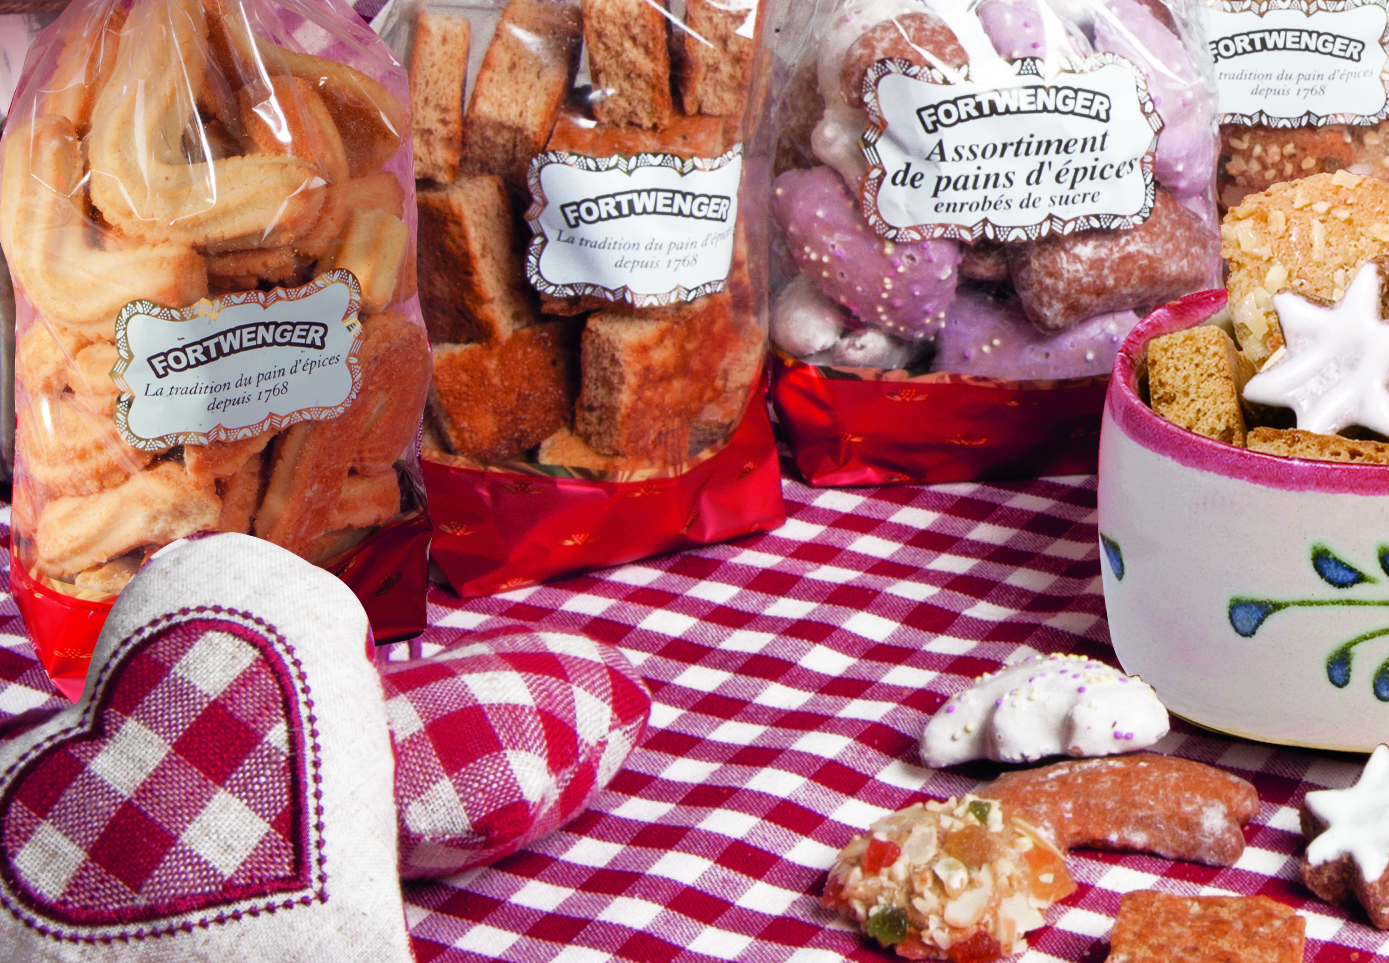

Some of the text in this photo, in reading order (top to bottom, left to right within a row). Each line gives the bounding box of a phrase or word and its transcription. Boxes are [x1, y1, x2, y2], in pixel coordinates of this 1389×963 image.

[1218, 67, 1374, 85] tradition du pain d'épices
[1250, 84, 1326, 100] depuis 1768
[916, 85, 1112, 134] FORTWENGER
[925, 129, 1109, 163] Assortiment
[890, 156, 1138, 198] de pains d'épices
[560, 188, 731, 229] FORTWENGER
[934, 190, 1101, 214] enrobés de sucre
[556, 230, 575, 245] La
[579, 236, 641, 251] tradition
[645, 237, 663, 251] du
[666, 239, 697, 256] pain
[614, 254, 699, 273] depuis 1768
[147, 321, 328, 379] FORTWENGER
[144, 353, 341, 398] La tradition du pain d'épices
[206, 381, 289, 414] depuis 1768
